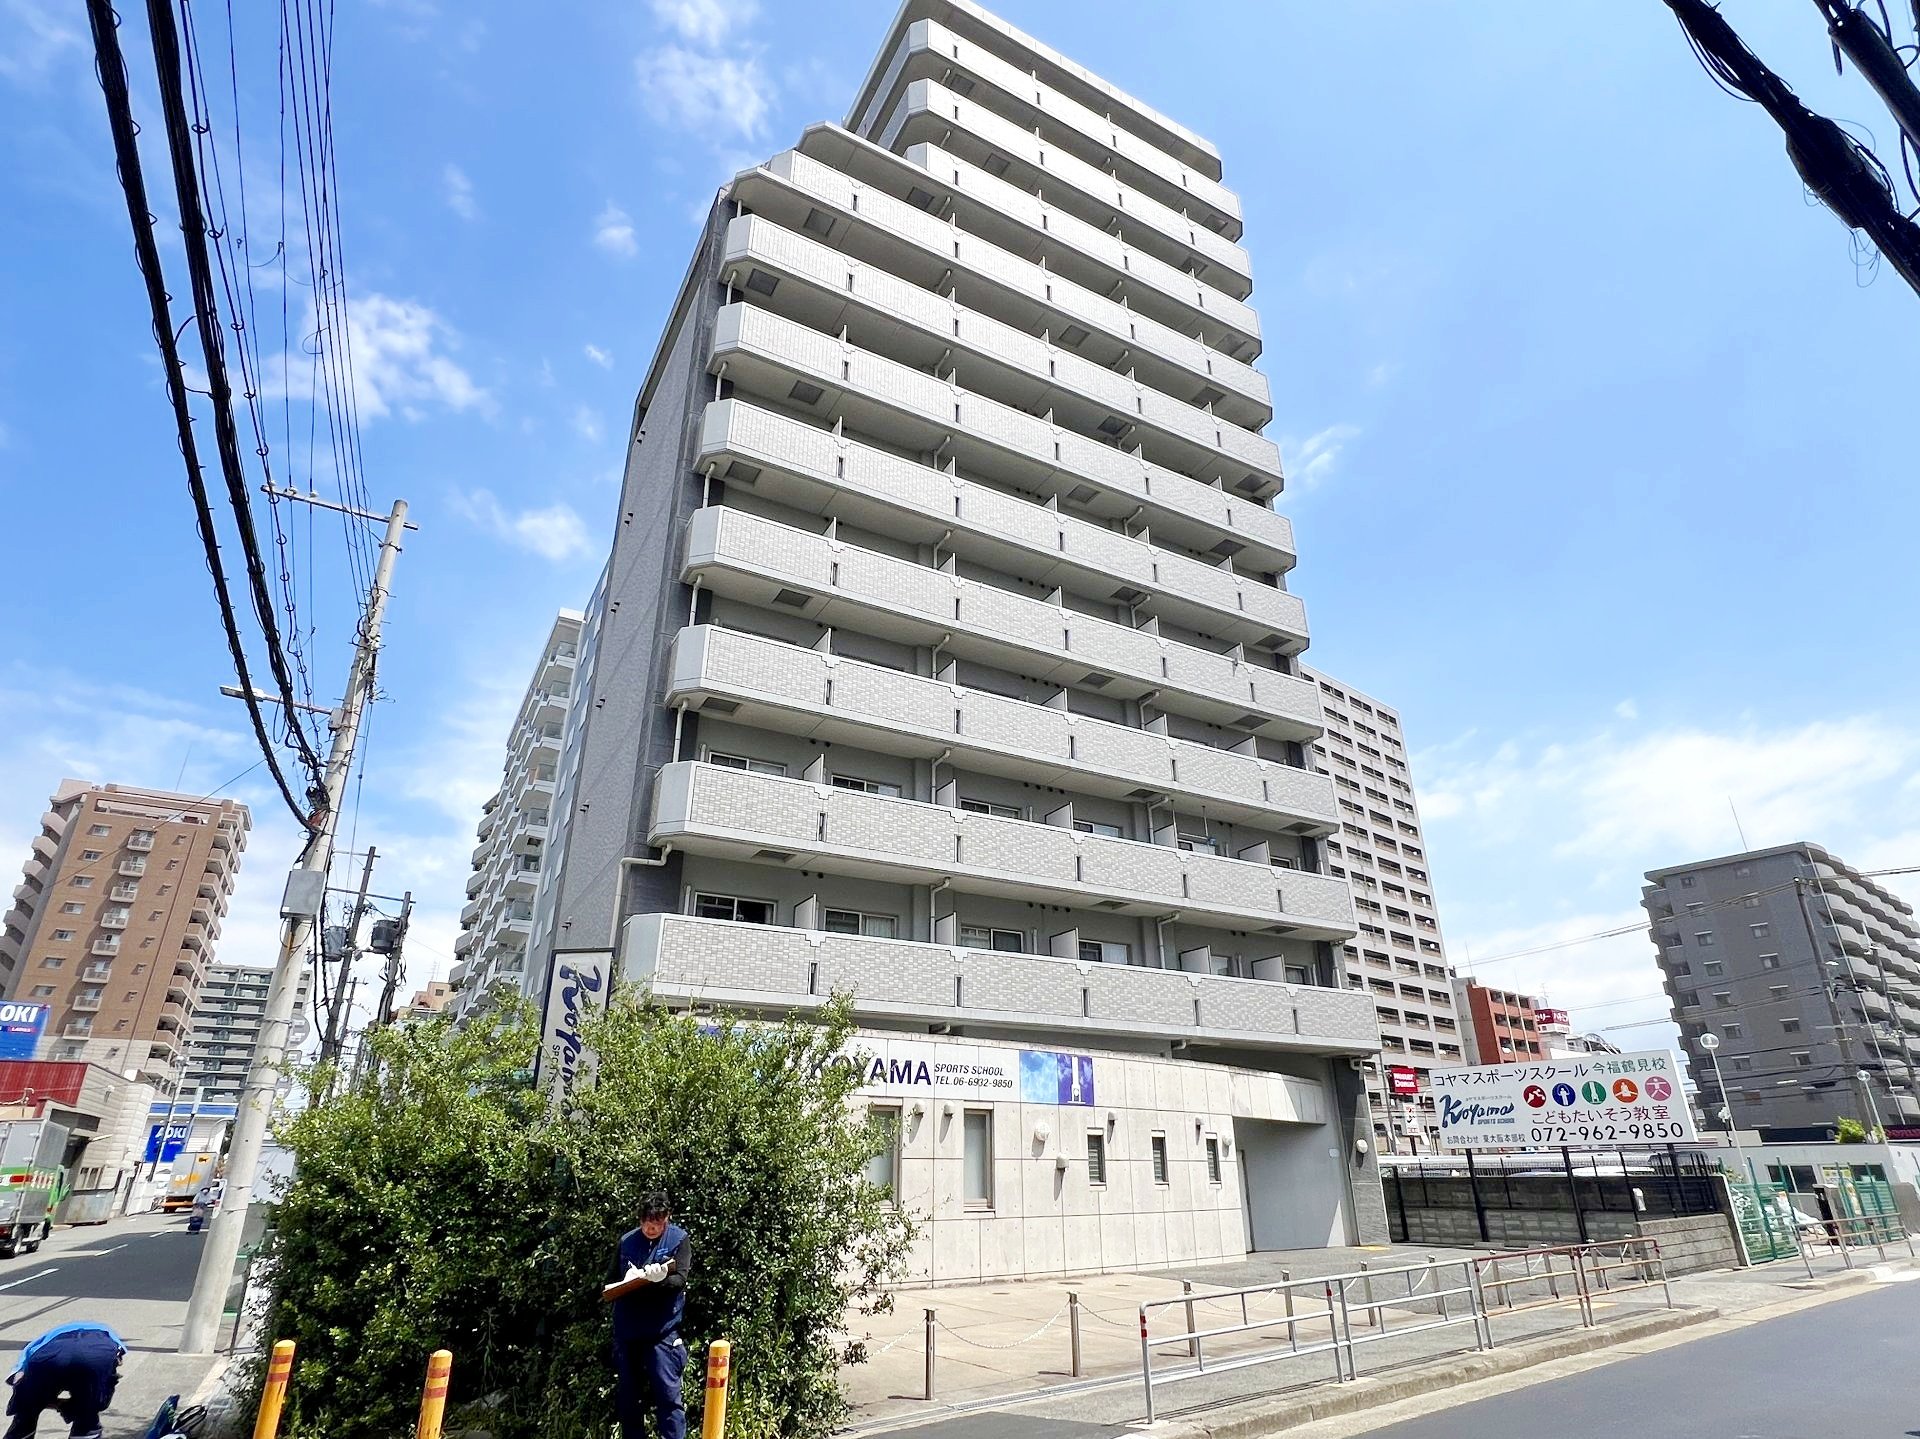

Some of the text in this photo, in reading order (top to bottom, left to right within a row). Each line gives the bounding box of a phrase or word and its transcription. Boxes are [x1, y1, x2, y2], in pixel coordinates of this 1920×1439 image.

[0, 1004, 39, 1023] OKI
[934, 1063, 1004, 1076] SPORTS SCHOOL
[1434, 1057, 1667, 1087] コヤマスポーツスクール 今福鶴見校
[935, 1075, 1013, 1089] TEL.06-6932-9850
[1439, 1095, 1514, 1128] Koyama
[1532, 1104, 1671, 1126] こどもたいそう教室
[1531, 1122, 1684, 1143] 072-962-9850
